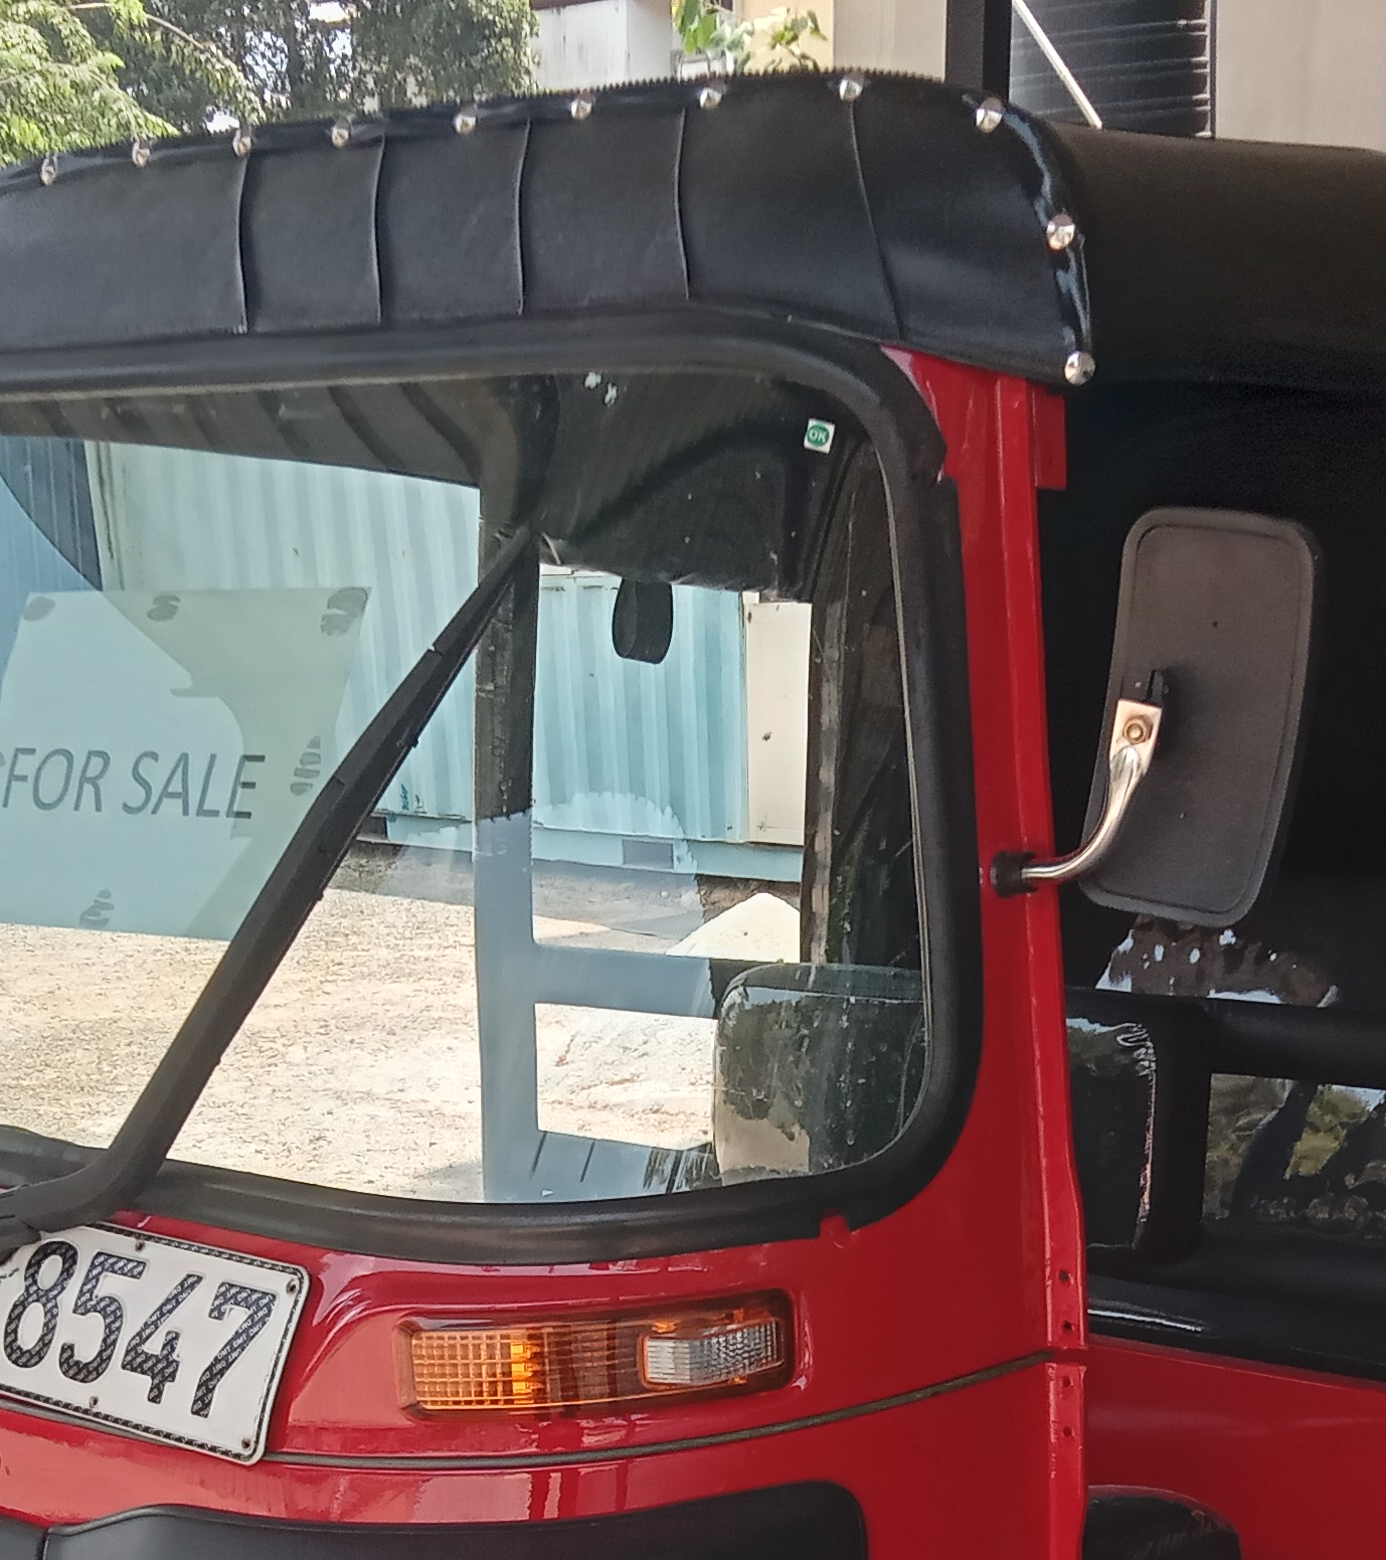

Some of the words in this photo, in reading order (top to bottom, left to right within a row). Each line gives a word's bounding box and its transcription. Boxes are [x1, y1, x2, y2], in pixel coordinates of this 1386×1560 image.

[808, 429, 827, 444] OK
[2, 747, 111, 813] FOR
[122, 750, 266, 820] SALE
[2, 1239, 278, 1419] 8547
